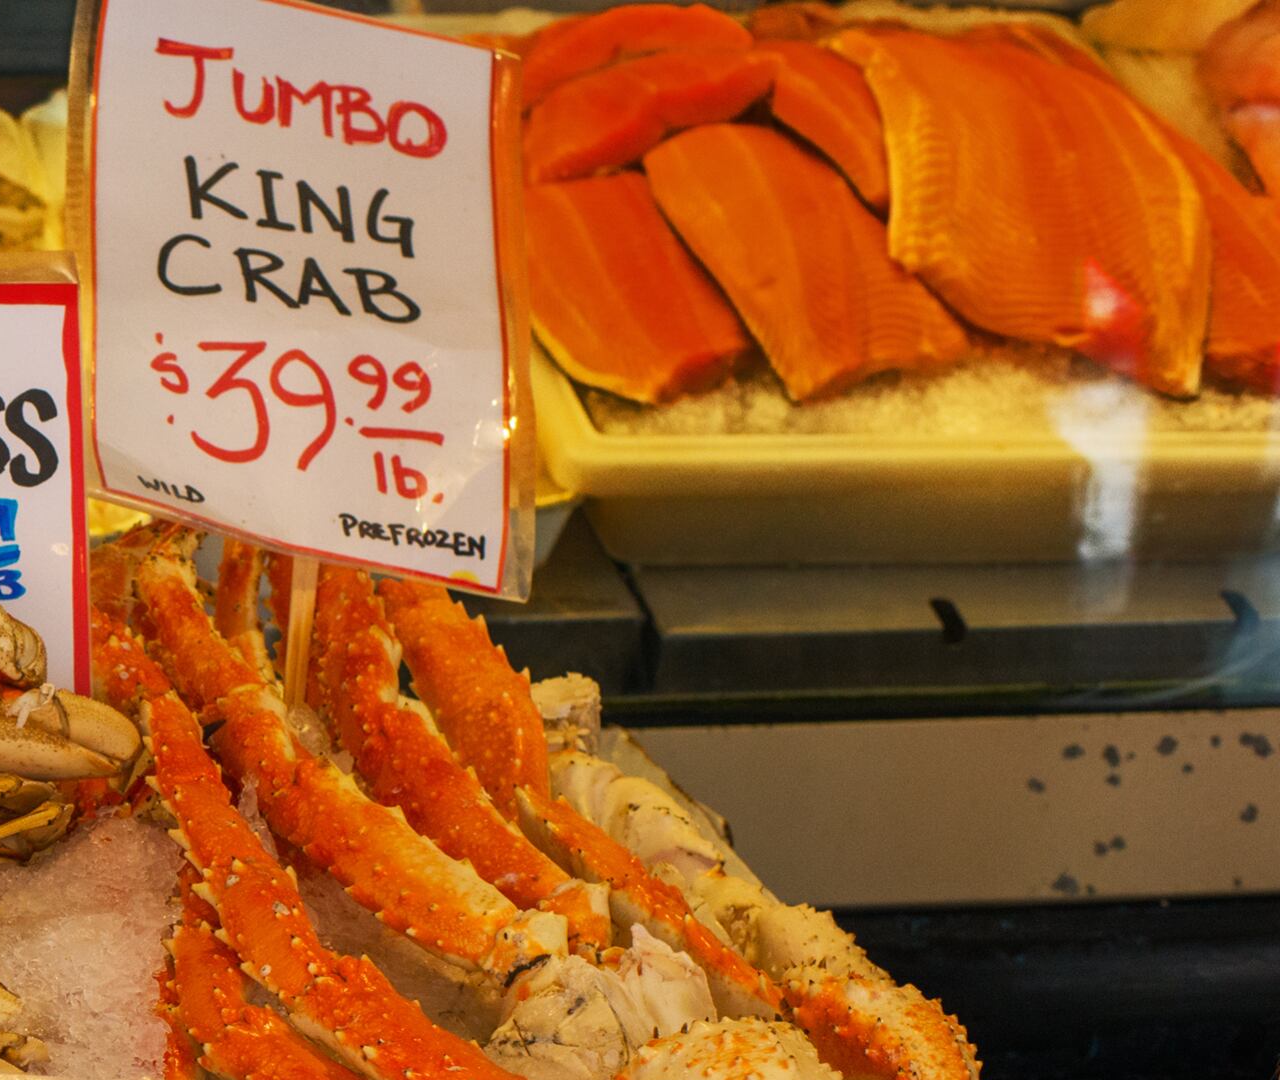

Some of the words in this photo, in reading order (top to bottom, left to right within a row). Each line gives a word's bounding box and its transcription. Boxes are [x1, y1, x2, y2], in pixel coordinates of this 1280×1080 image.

[155, 37, 448, 159] JUMBO
[183, 155, 416, 260] KING
[156, 233, 421, 324] CRAB
[137, 475, 206, 503] WILD
[339, 513, 486, 560] PREFROZEN
